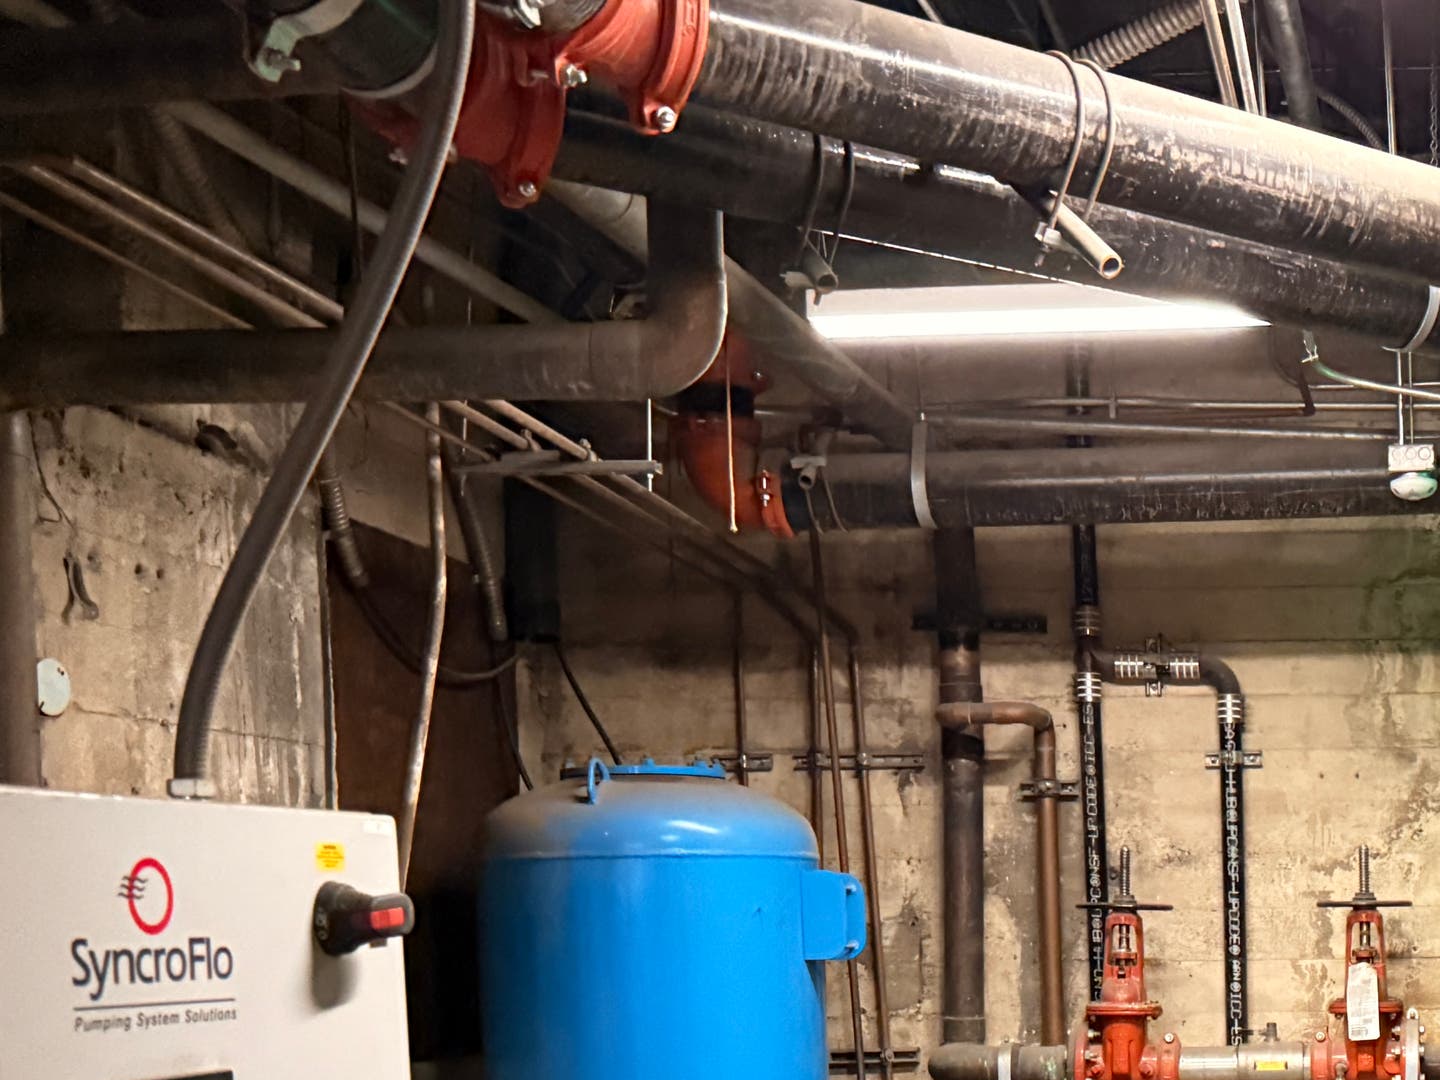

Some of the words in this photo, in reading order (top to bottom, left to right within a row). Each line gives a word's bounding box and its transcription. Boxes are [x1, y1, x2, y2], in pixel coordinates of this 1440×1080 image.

[71, 937, 234, 1001] SyncroFlo
[74, 1015, 132, 1033] Pumping
[136, 1011, 180, 1029] System
[184, 1007, 237, 1024] Solutions
